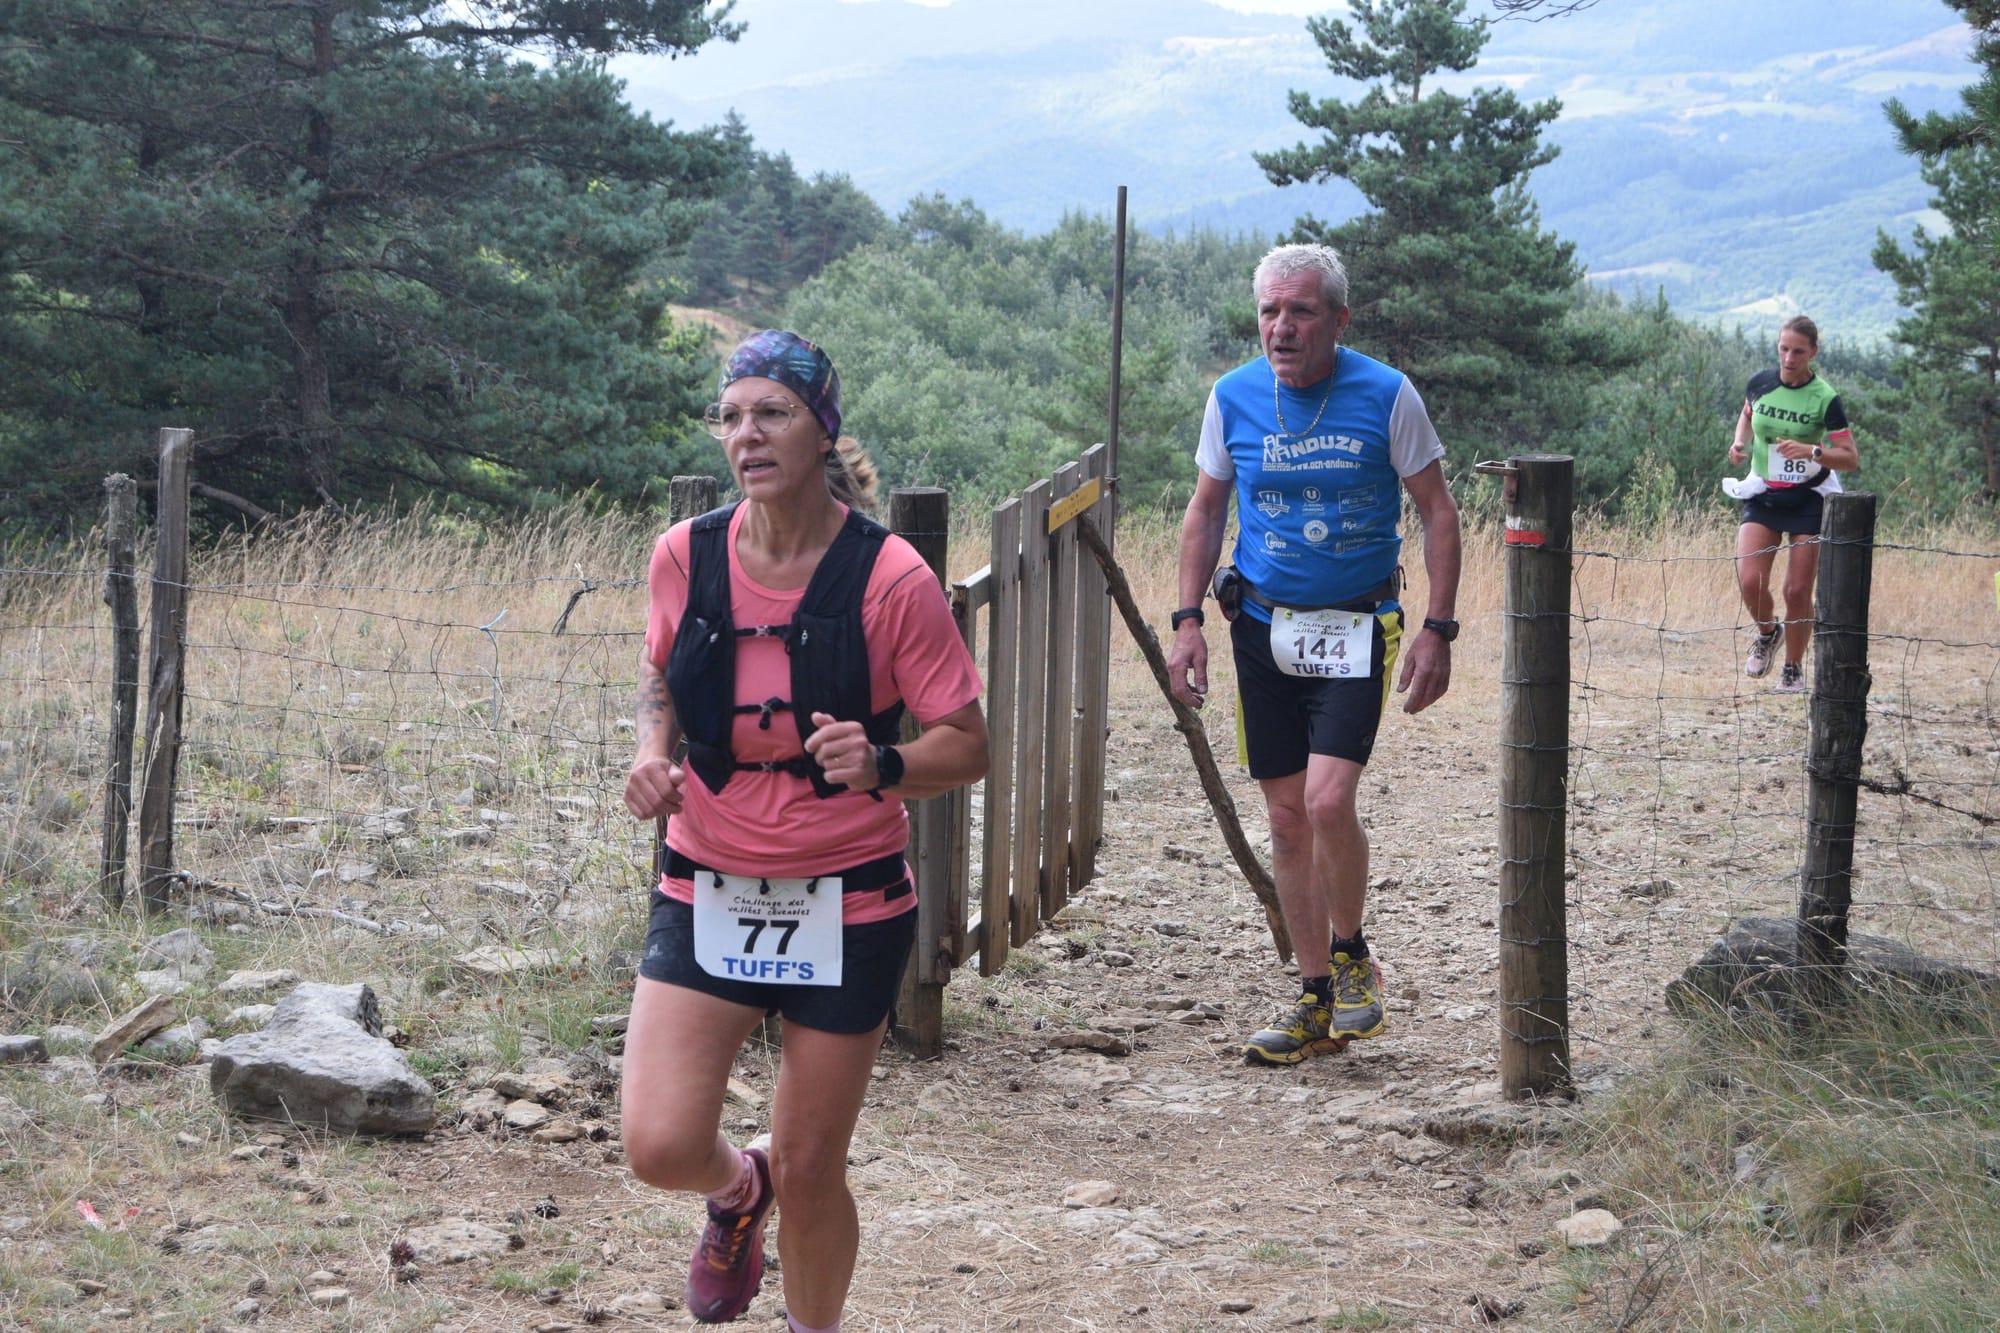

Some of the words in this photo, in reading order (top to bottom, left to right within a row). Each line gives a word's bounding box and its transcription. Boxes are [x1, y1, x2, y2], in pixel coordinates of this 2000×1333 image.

[1784, 459, 1806, 473] 86
[1294, 636, 1346, 659] 144
[1291, 663, 1351, 675] TUFF'S
[733, 896, 782, 908] Challenge
[738, 917, 799, 955] 77
[722, 957, 814, 980] TUFF'S
